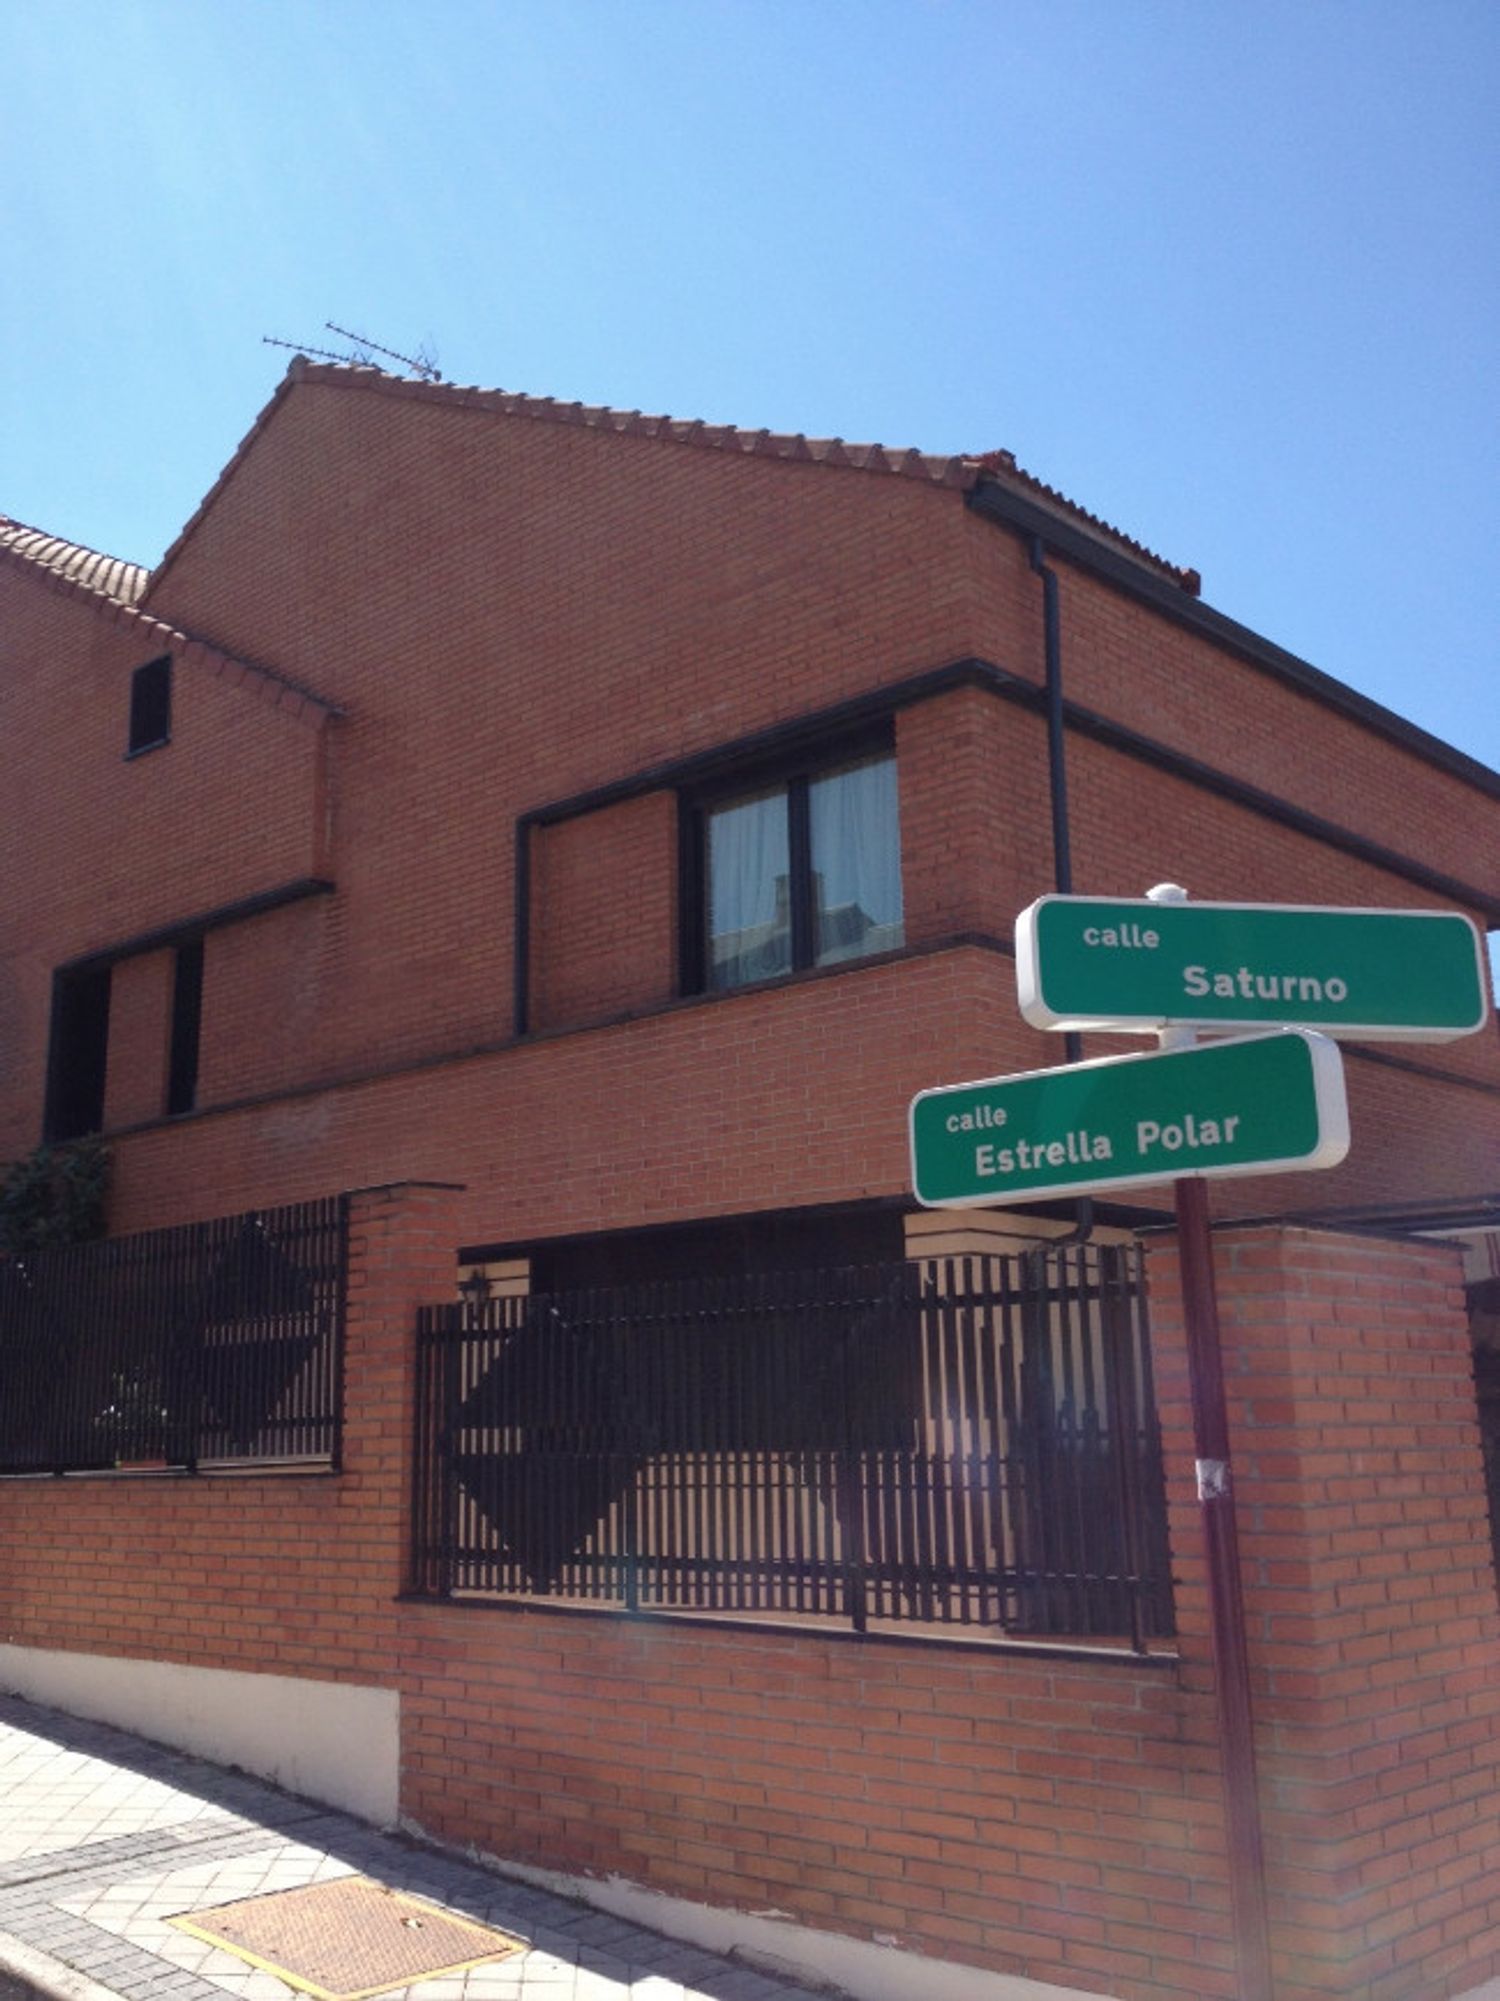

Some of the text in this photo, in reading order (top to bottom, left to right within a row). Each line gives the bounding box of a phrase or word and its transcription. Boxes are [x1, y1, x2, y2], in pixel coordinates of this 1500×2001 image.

[1083, 924, 1160, 948] calle
[1183, 965, 1348, 1002] Saturno
[946, 1105, 1007, 1133] calle
[975, 1114, 1239, 1176] Estrella Polar
